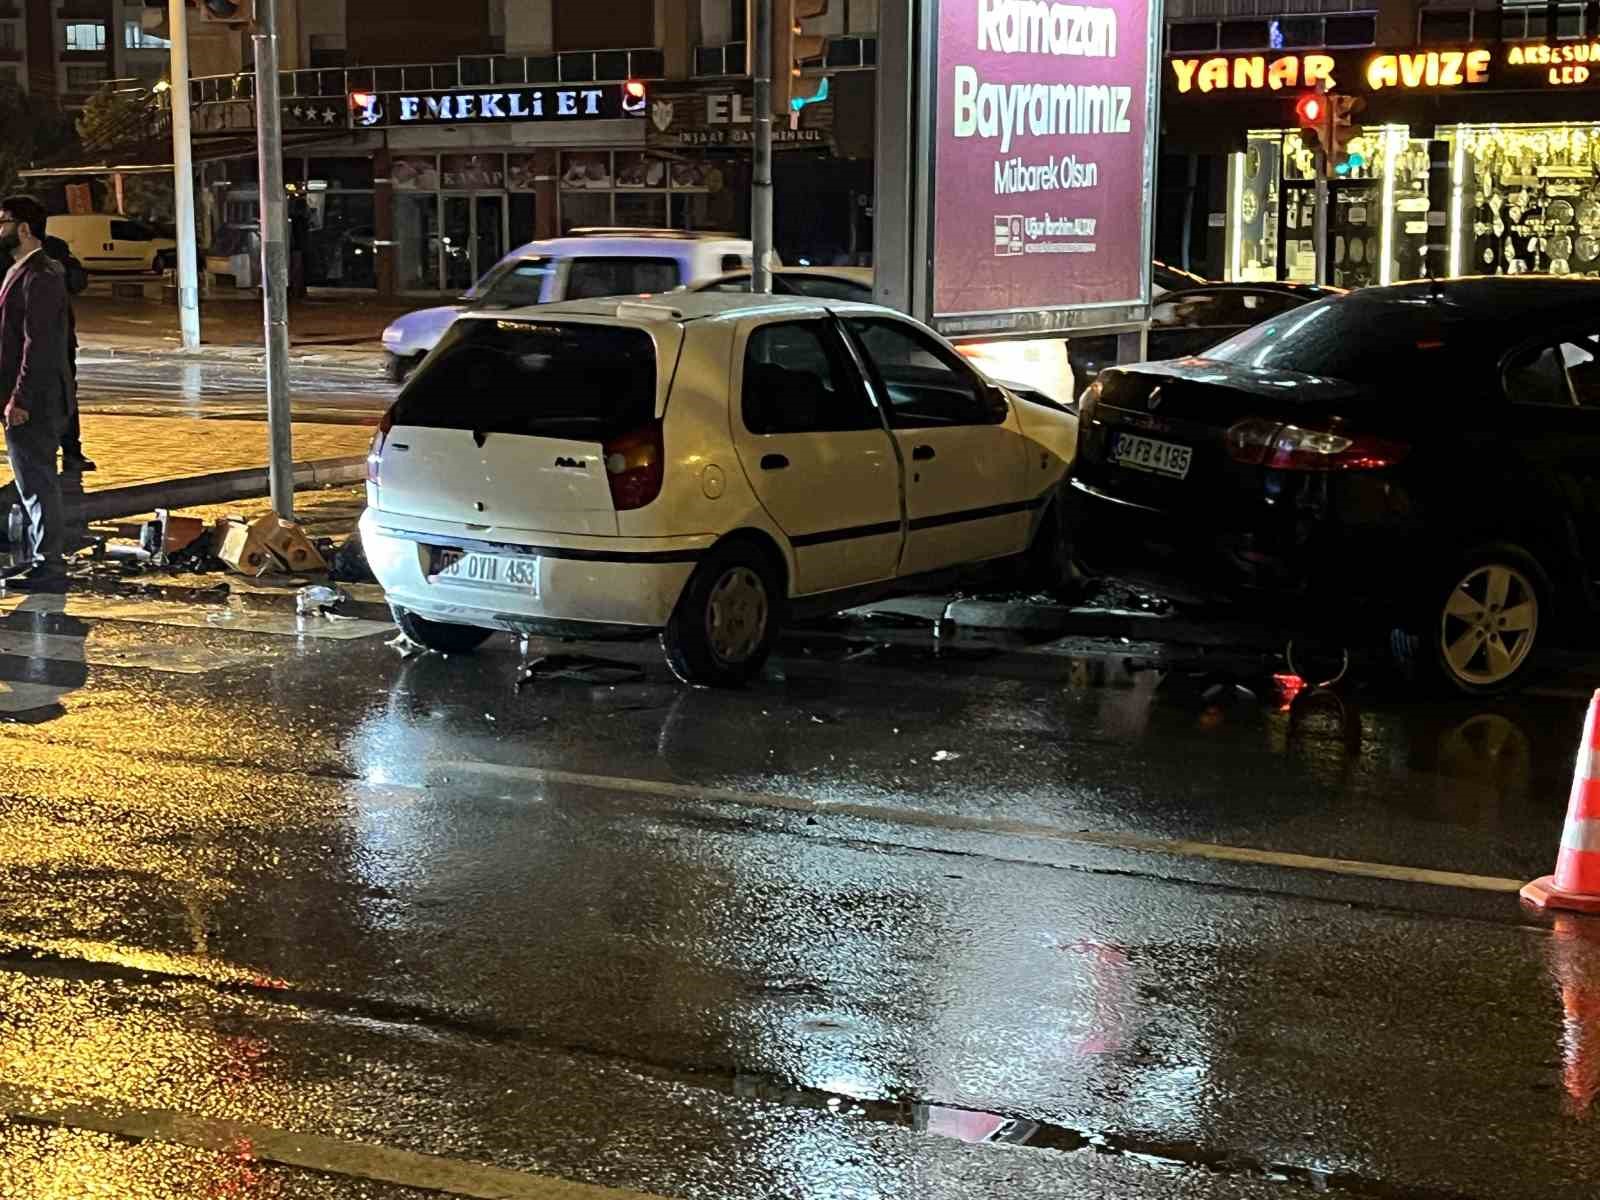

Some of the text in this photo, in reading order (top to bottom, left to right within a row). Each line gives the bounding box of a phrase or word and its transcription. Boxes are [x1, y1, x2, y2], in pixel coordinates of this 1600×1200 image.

[977, 0, 1117, 57] Ramazan
[1171, 55, 1336, 93] YANAR
[1548, 66, 1589, 84] LED
[557, 89, 602, 116] ET
[954, 65, 1131, 153] Bayramımız
[994, 154, 1097, 194] Mübarek Olsun
